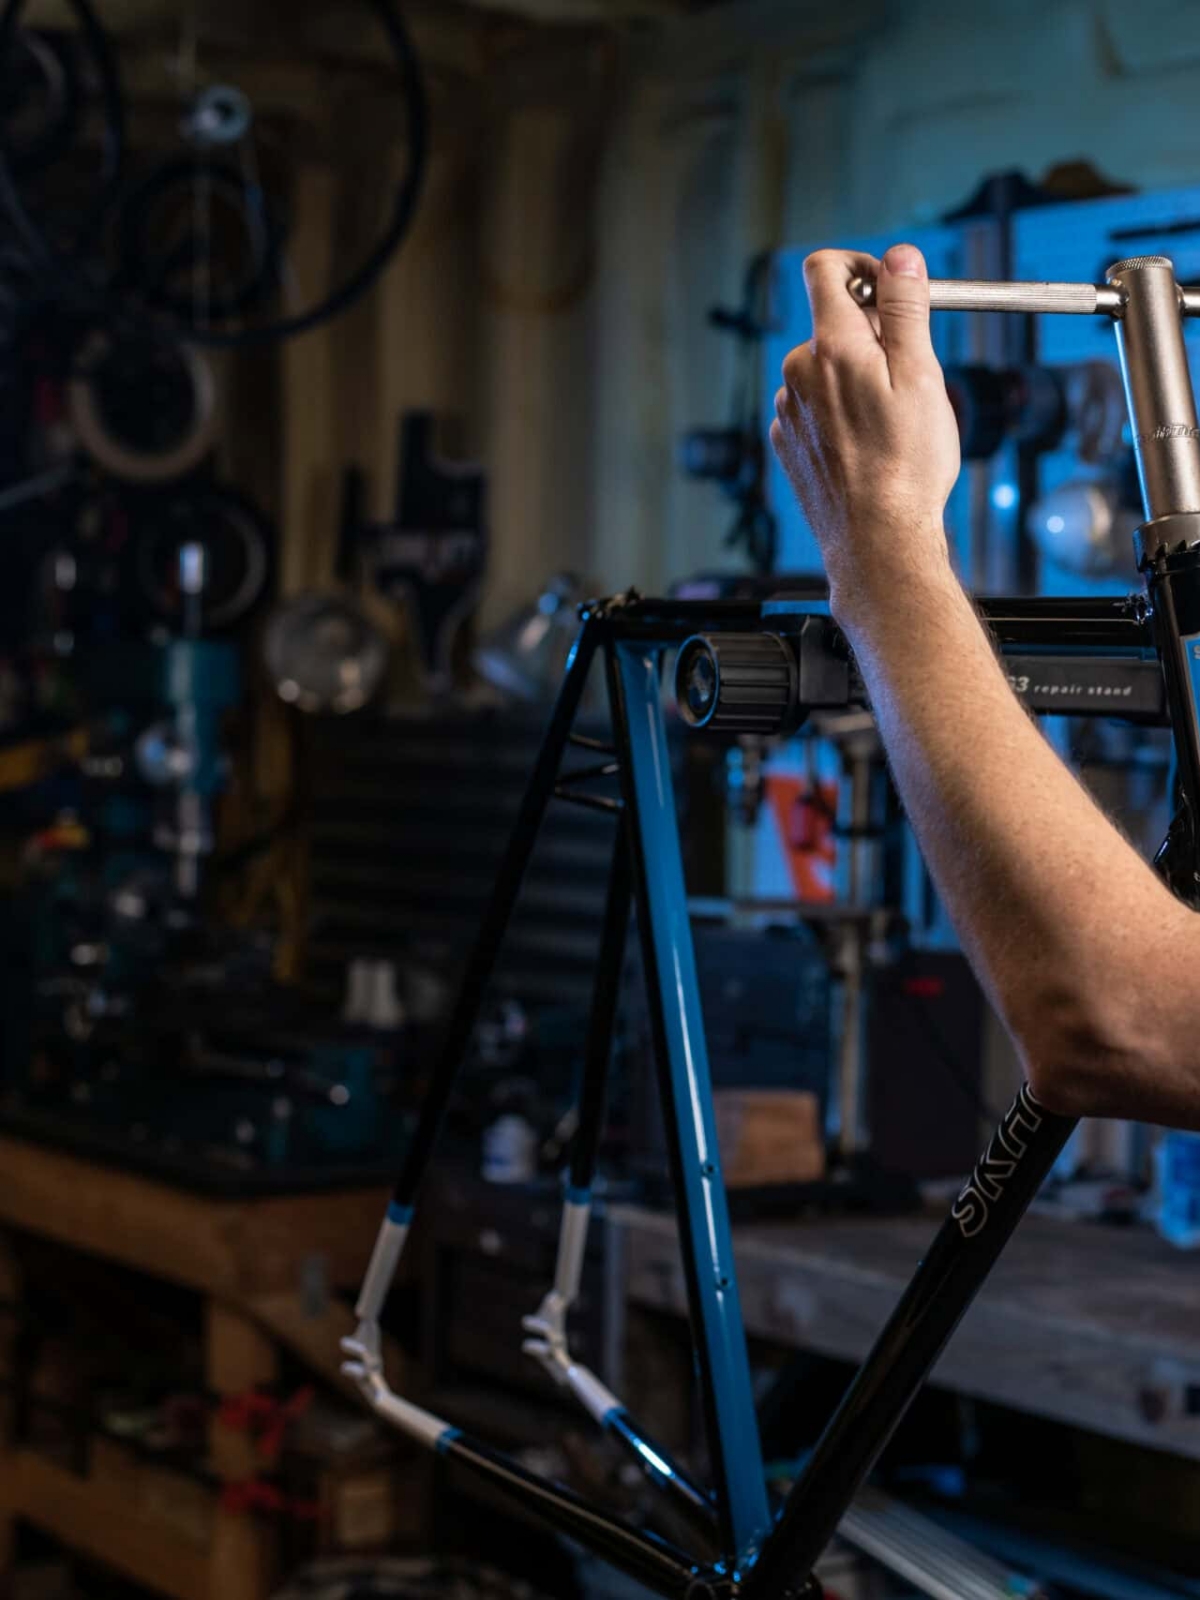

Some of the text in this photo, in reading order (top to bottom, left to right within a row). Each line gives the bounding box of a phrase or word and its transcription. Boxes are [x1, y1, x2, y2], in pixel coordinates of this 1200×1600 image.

[1034, 684, 1084, 695] repair
[1088, 685, 1132, 697] stand
[951, 1080, 1043, 1238] SKH
